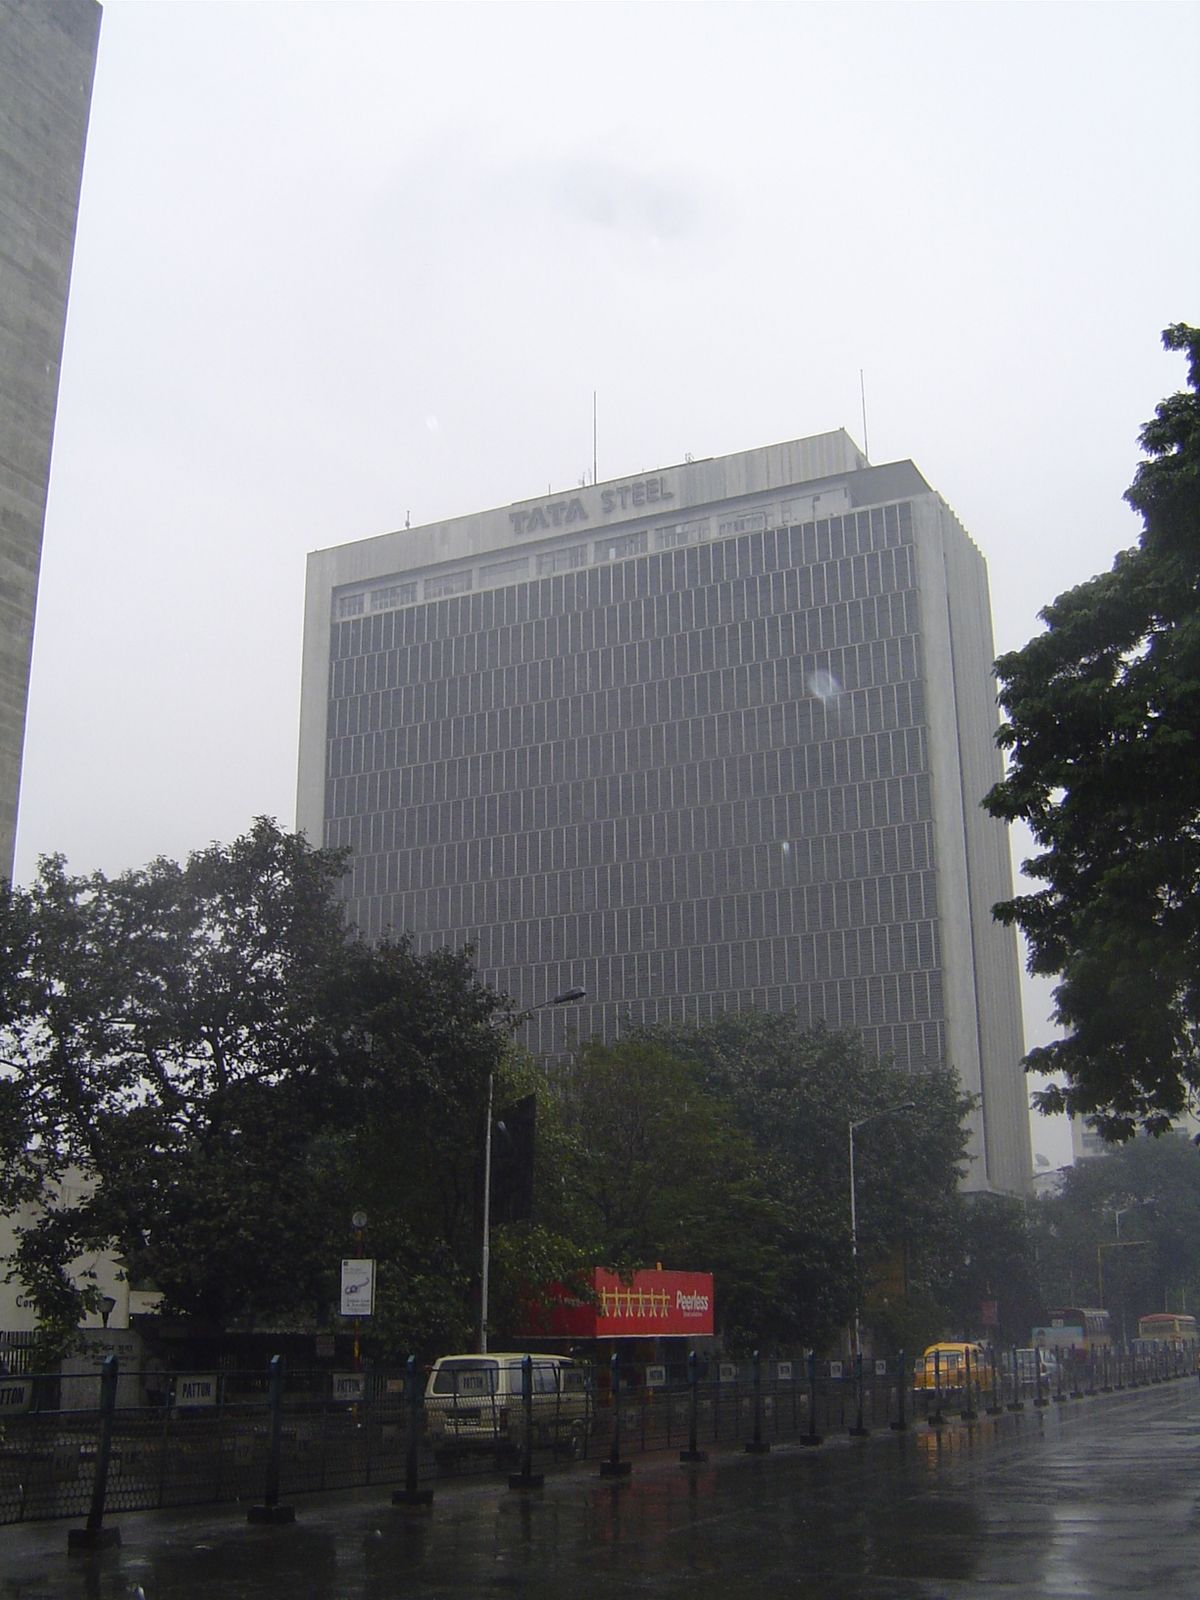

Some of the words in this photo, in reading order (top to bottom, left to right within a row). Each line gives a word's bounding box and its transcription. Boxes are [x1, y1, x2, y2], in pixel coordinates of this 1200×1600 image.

[508, 497, 589, 535] TATA
[600, 475, 674, 514] STEEL
[676, 1289, 709, 1312] Peerless
[182, 1381, 212, 1399] PATTON
[336, 1378, 361, 1393] PATTON
[0, 1386, 25, 1405] TTON
